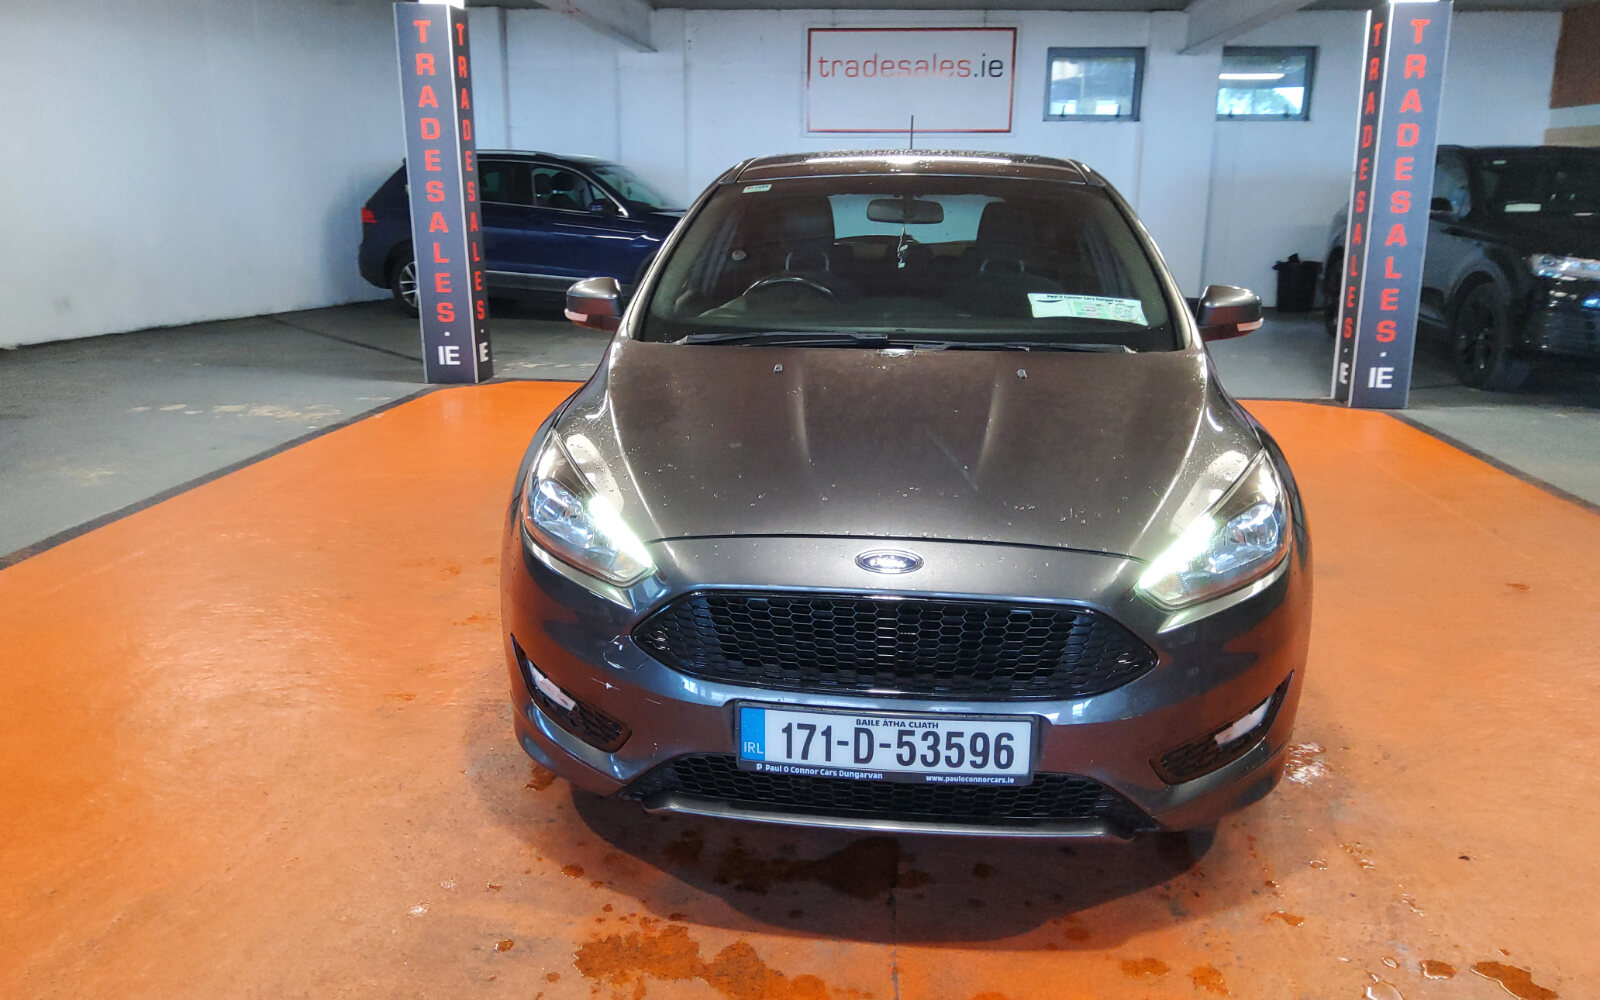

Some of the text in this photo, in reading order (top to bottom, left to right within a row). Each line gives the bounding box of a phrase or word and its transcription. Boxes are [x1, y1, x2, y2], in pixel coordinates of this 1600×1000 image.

[817, 53, 1004, 78] tradesales.ie
[856, 718, 939, 729] BAILE ÁTHA CLIATH
[743, 741, 764, 754] IRL
[781, 722, 1015, 769] 171-D-53596
[765, 764, 782, 773] Paul
[790, 766, 818, 775] Connor
[819, 768, 838, 777] Cars
[839, 770, 883, 780] Dungarvan
